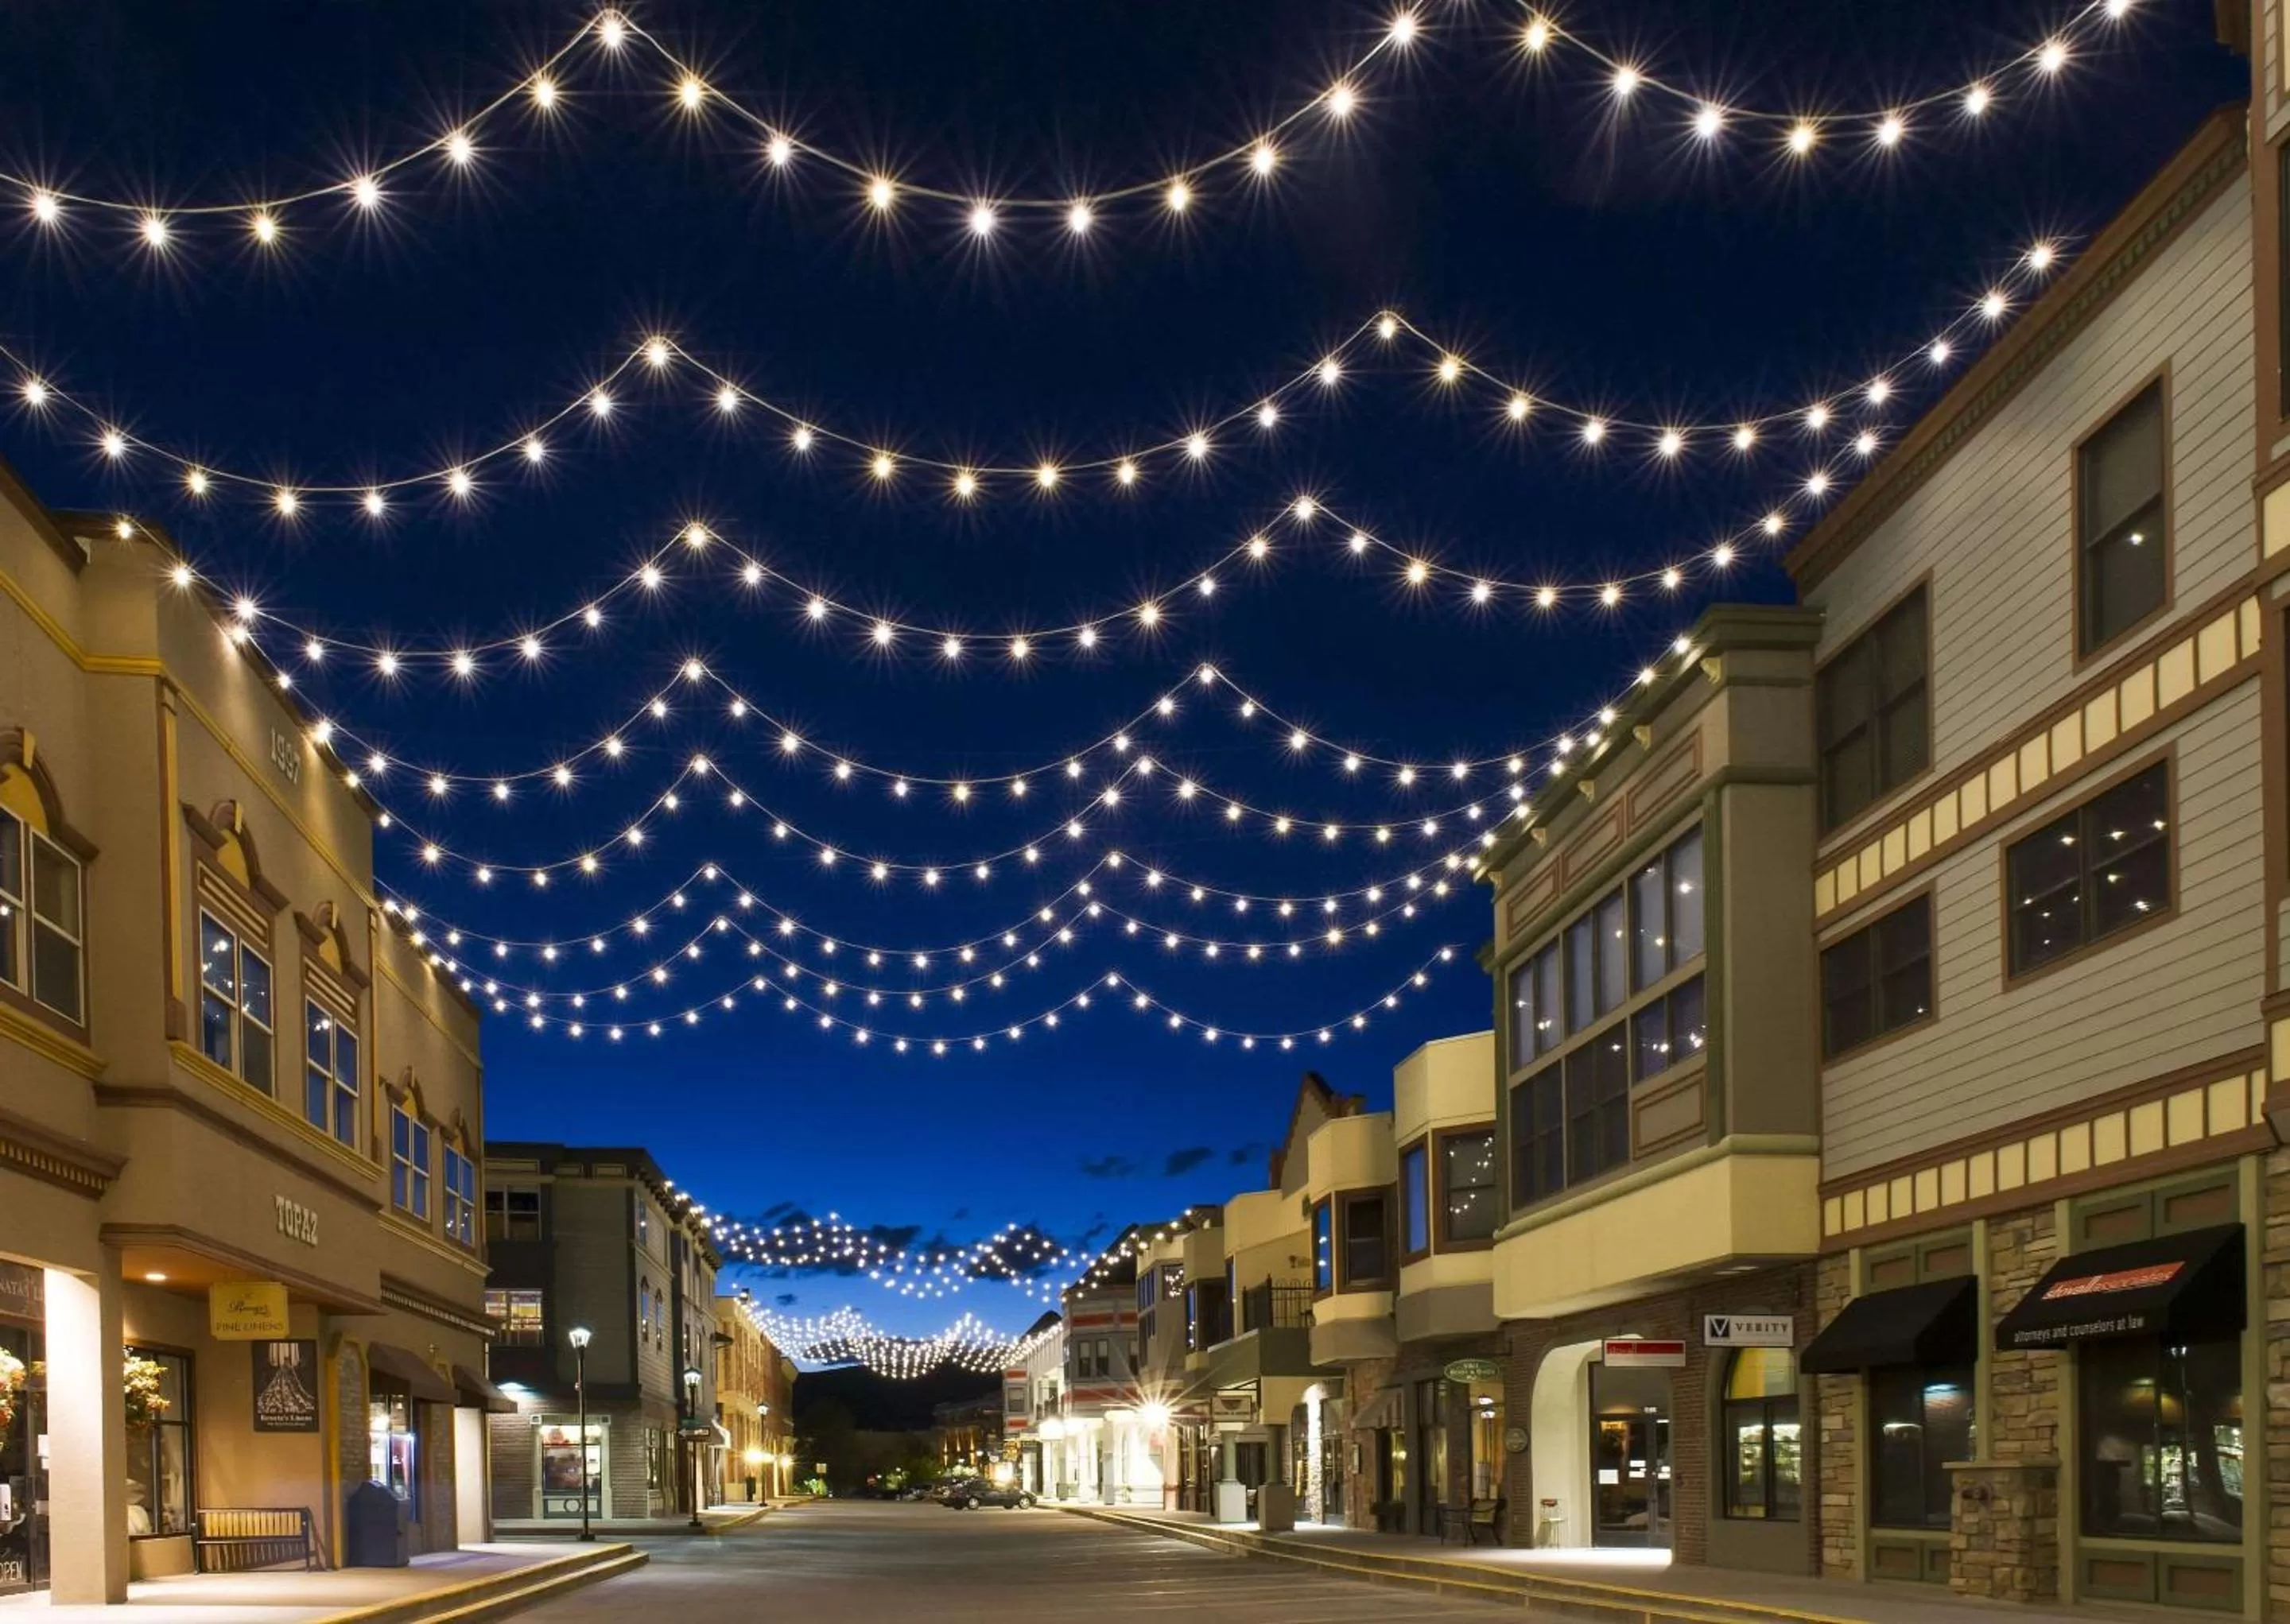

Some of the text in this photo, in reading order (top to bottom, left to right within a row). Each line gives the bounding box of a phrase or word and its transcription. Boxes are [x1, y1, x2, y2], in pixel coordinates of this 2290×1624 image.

[271, 727, 300, 785] 1997
[275, 1196, 318, 1246] TOPAZ
[1735, 1322, 1788, 1333] VERITY
[2014, 1329, 2051, 1343] attorneys
[2052, 1324, 2067, 1338] and
[2117, 1317, 2126, 1331] at
[2128, 1313, 2144, 1329] law
